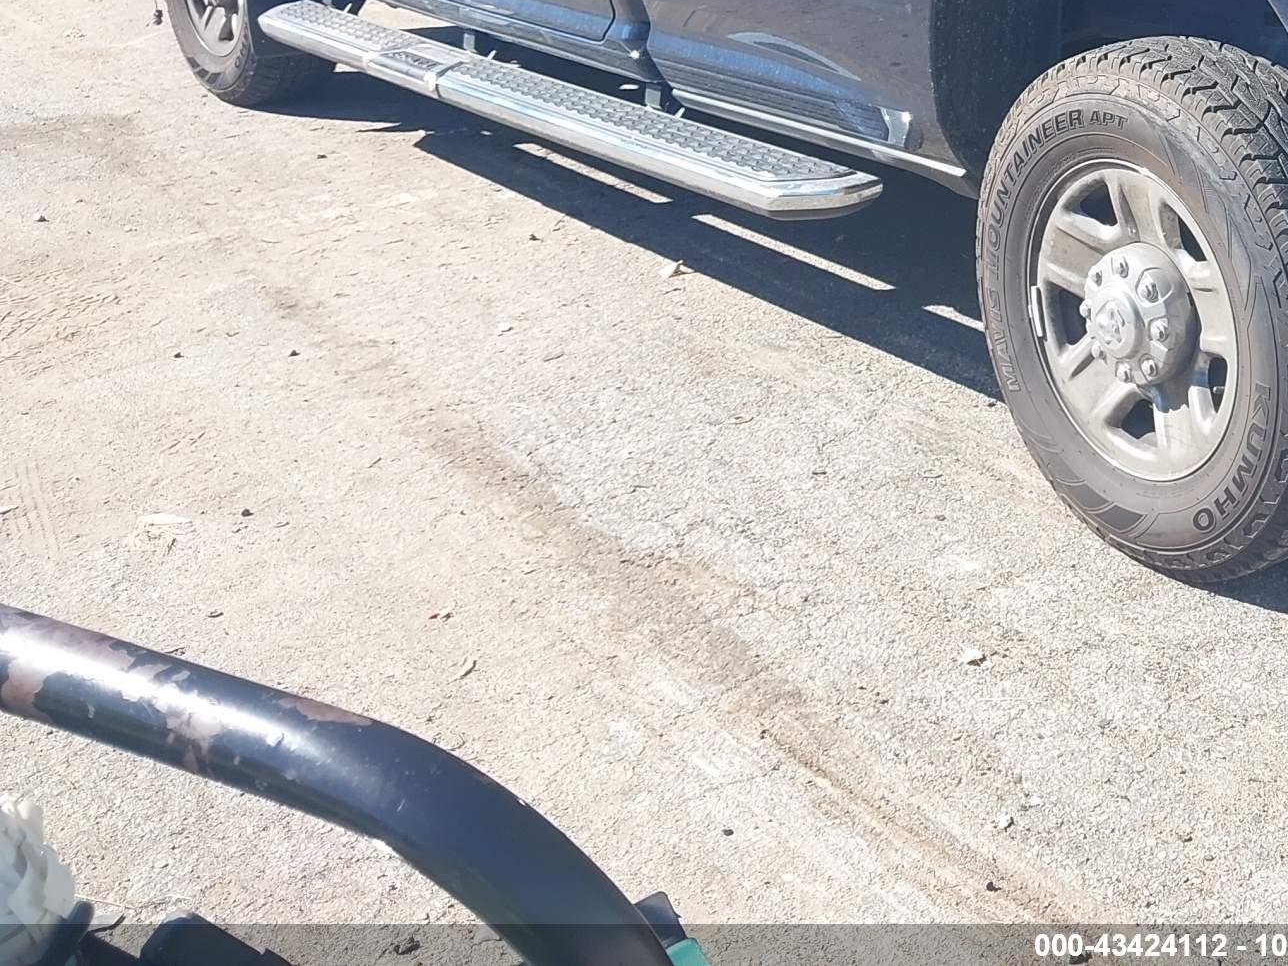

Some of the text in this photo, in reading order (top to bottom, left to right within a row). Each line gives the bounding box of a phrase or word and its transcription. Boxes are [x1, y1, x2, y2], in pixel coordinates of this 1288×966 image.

[1089, 108, 1129, 131] APT
[986, 108, 1086, 278] MOUNTAINEER
[986, 286, 1021, 392] MAVIS
[1192, 380, 1271, 534] KUMHO
